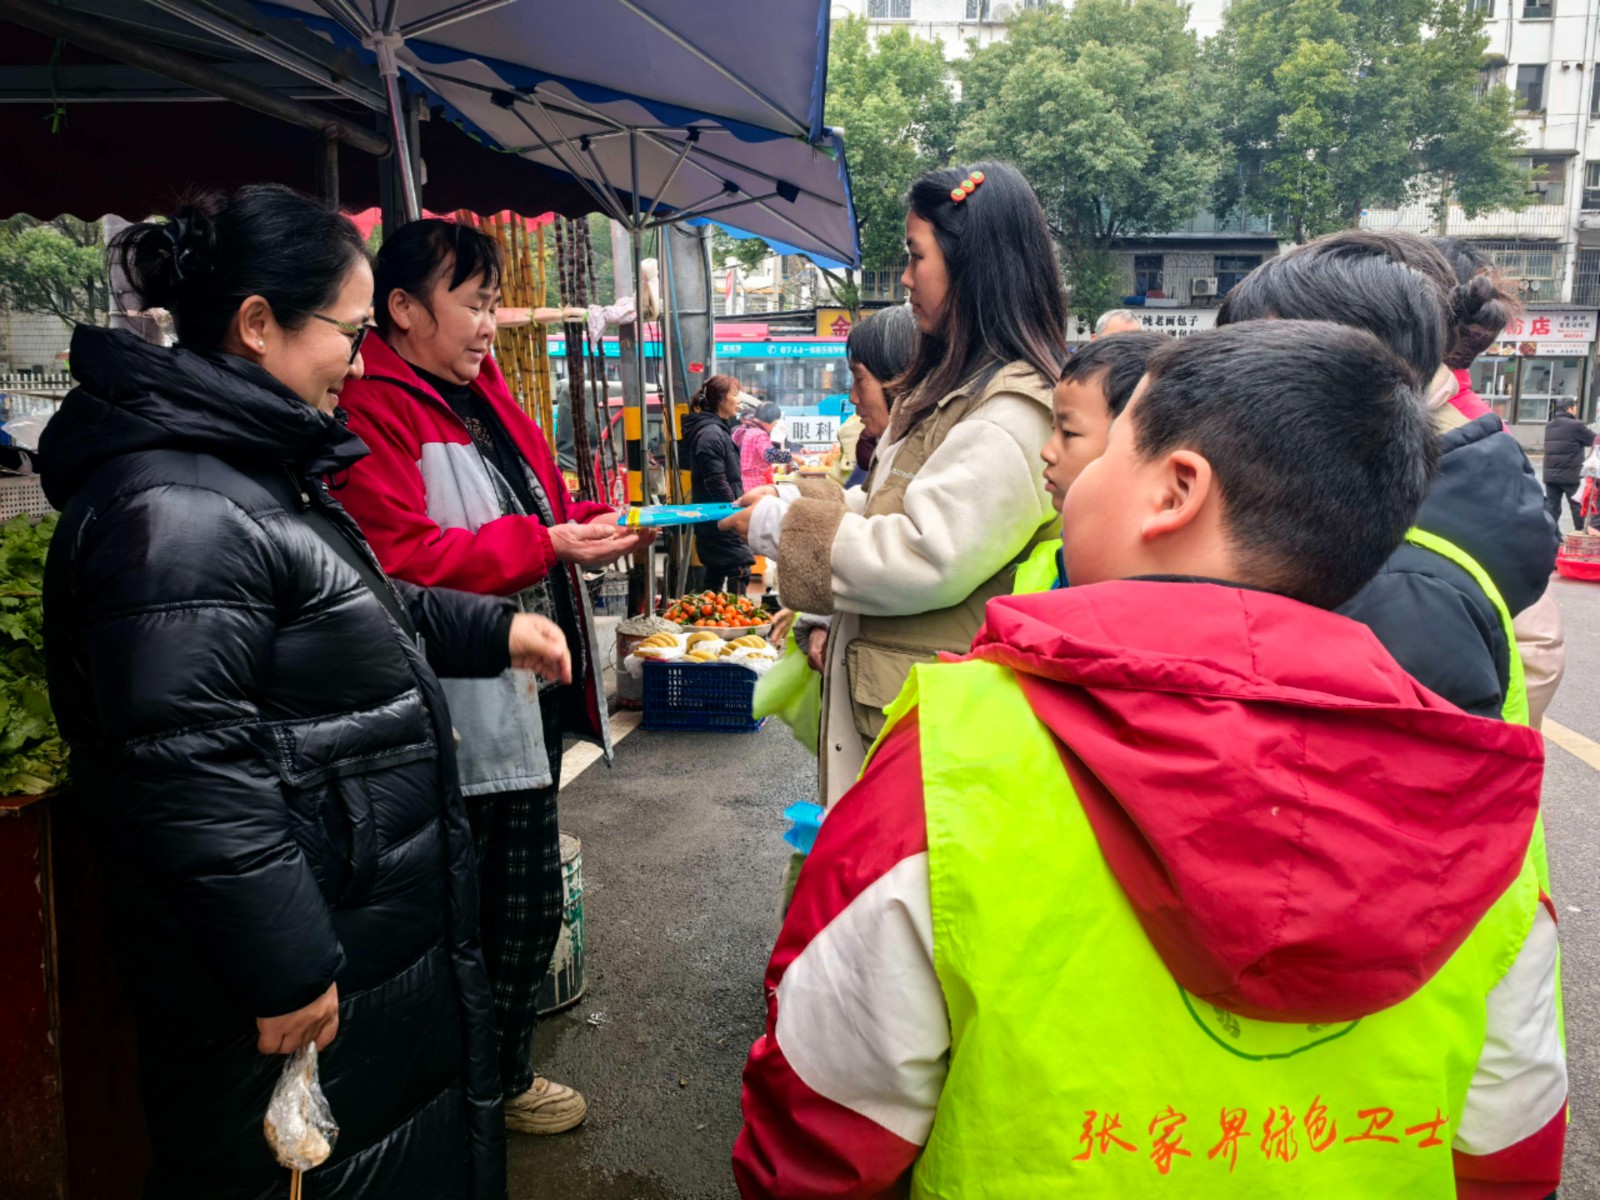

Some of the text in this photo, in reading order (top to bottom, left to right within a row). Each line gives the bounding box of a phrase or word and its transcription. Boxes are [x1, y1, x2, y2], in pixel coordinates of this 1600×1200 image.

[1138, 315, 1199, 326] 纯老面包子
[793, 421, 834, 441] 眼科
[1071, 1095, 1449, 1175] 张家界绿色卫士
